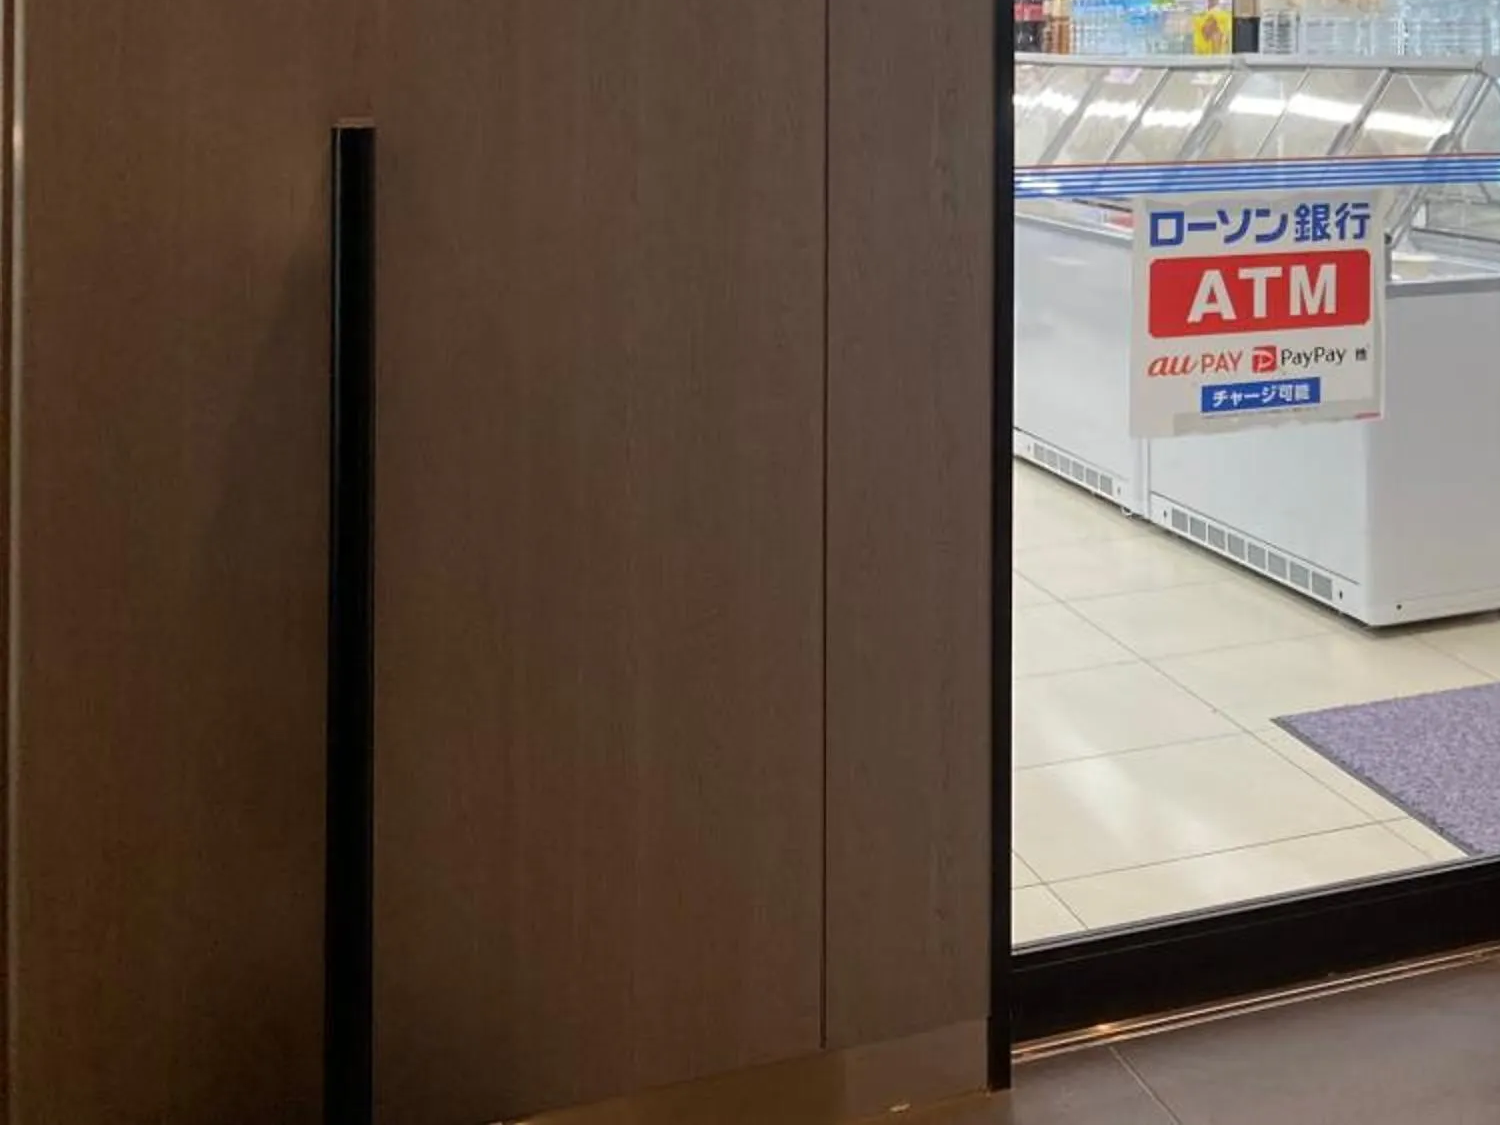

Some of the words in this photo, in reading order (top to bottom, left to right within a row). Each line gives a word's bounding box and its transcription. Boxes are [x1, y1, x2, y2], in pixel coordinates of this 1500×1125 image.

[1150, 202, 1371, 248] ローソン銀行
[1186, 263, 1337, 324] ATM
[1201, 350, 1243, 374] PAY
[1281, 346, 1347, 369] PayPay
